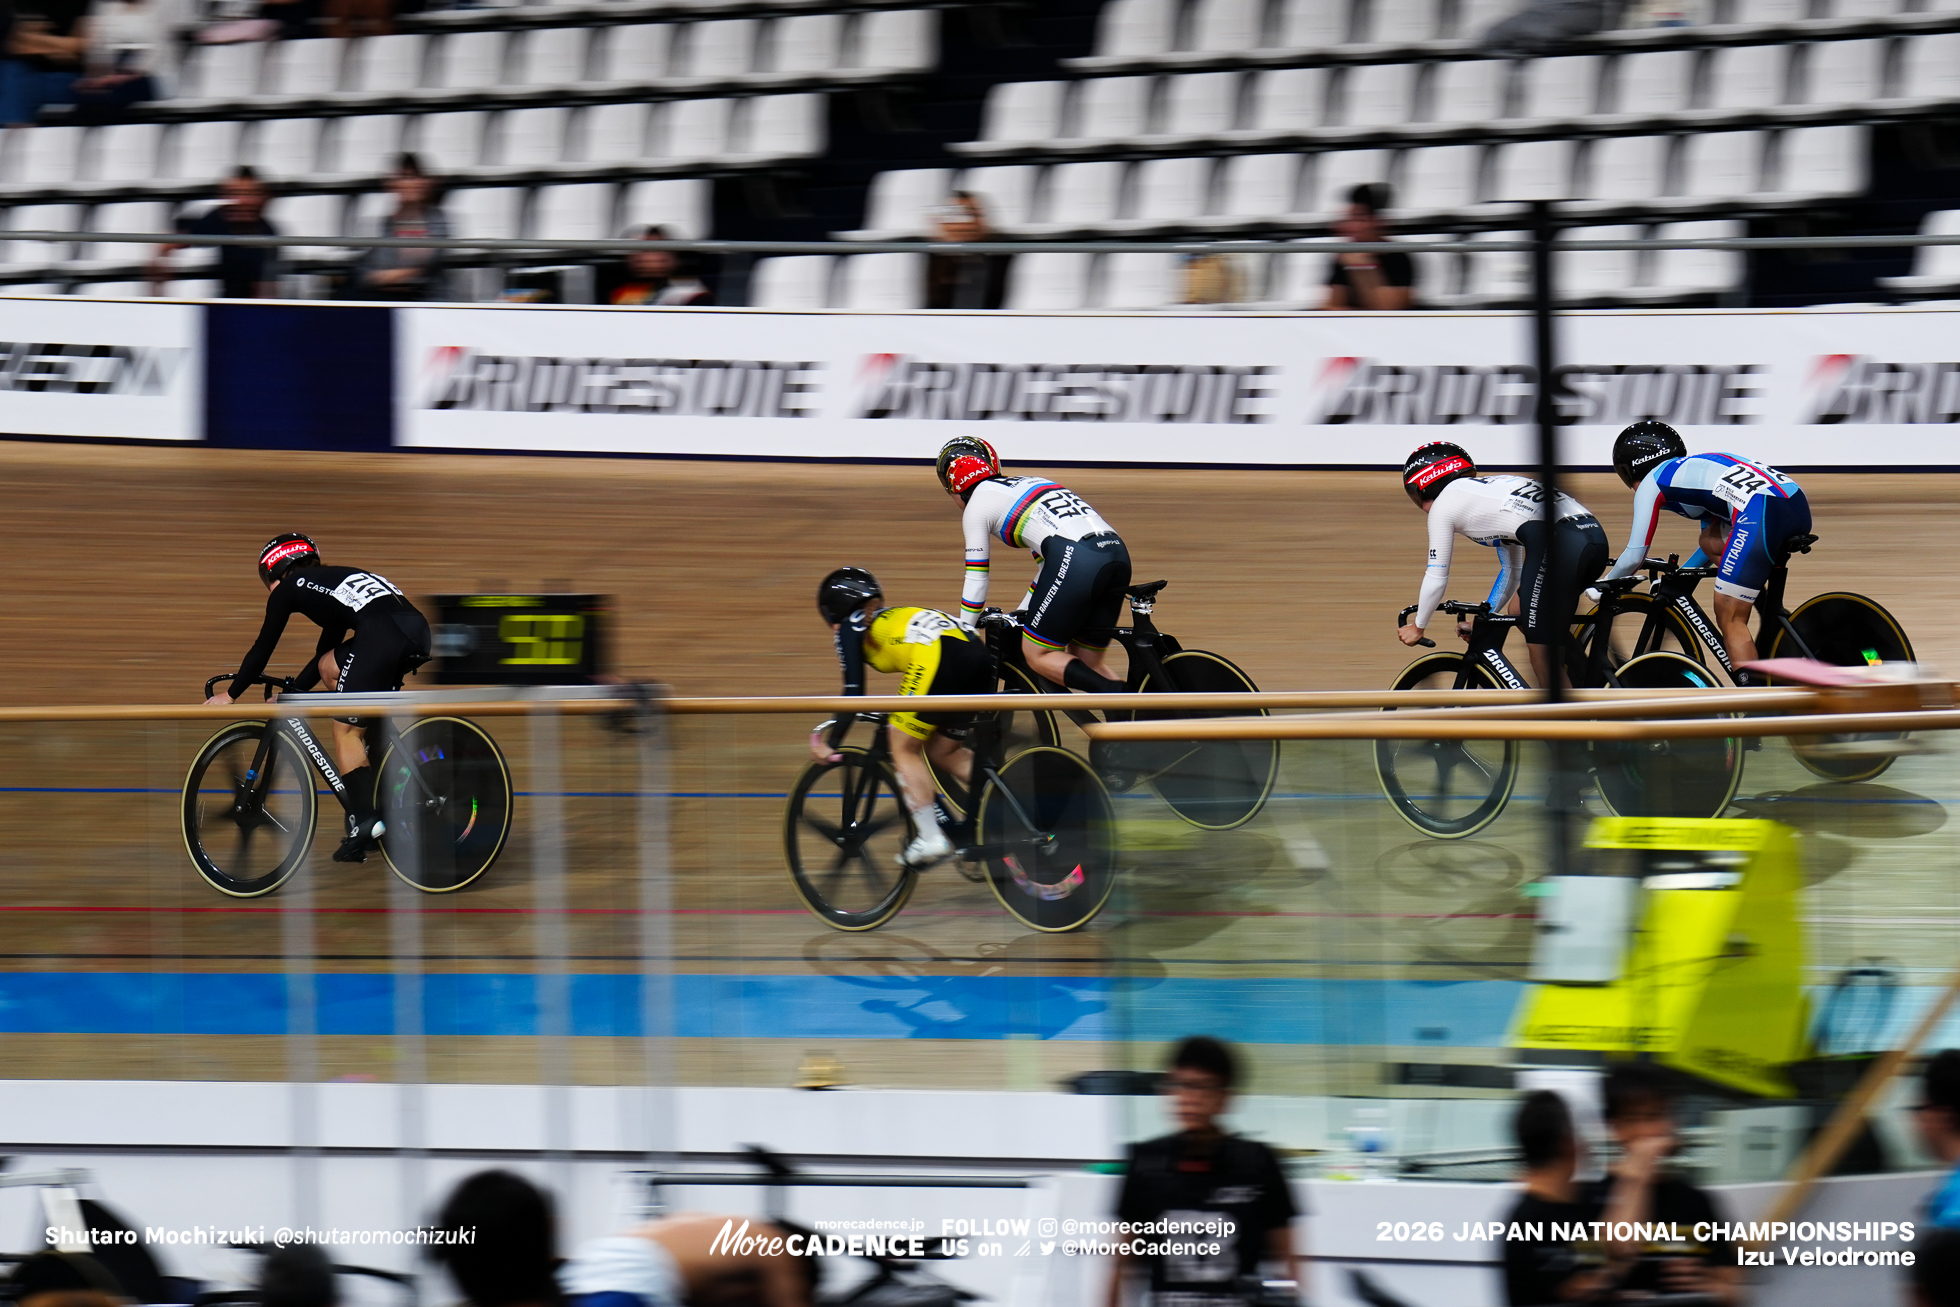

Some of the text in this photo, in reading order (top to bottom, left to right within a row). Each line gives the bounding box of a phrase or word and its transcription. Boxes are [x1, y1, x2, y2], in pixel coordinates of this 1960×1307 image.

[1632, 448, 1670, 467] Kabuto
[960, 466, 989, 485] JAPAN
[1419, 460, 1462, 487] Kabuto
[1721, 465, 1767, 495] 224
[1041, 492, 1081, 519] 227
[1721, 528, 1749, 577] NITTAIDAI
[1030, 545, 1075, 629] TEAM RAKUTEN K DREAMS
[1530, 573, 1546, 609] RAKUTEN
[1528, 610, 1538, 628] TEAM
[1483, 648, 1525, 690] BRIDG
[287, 717, 345, 792] BRIDGESTONE
